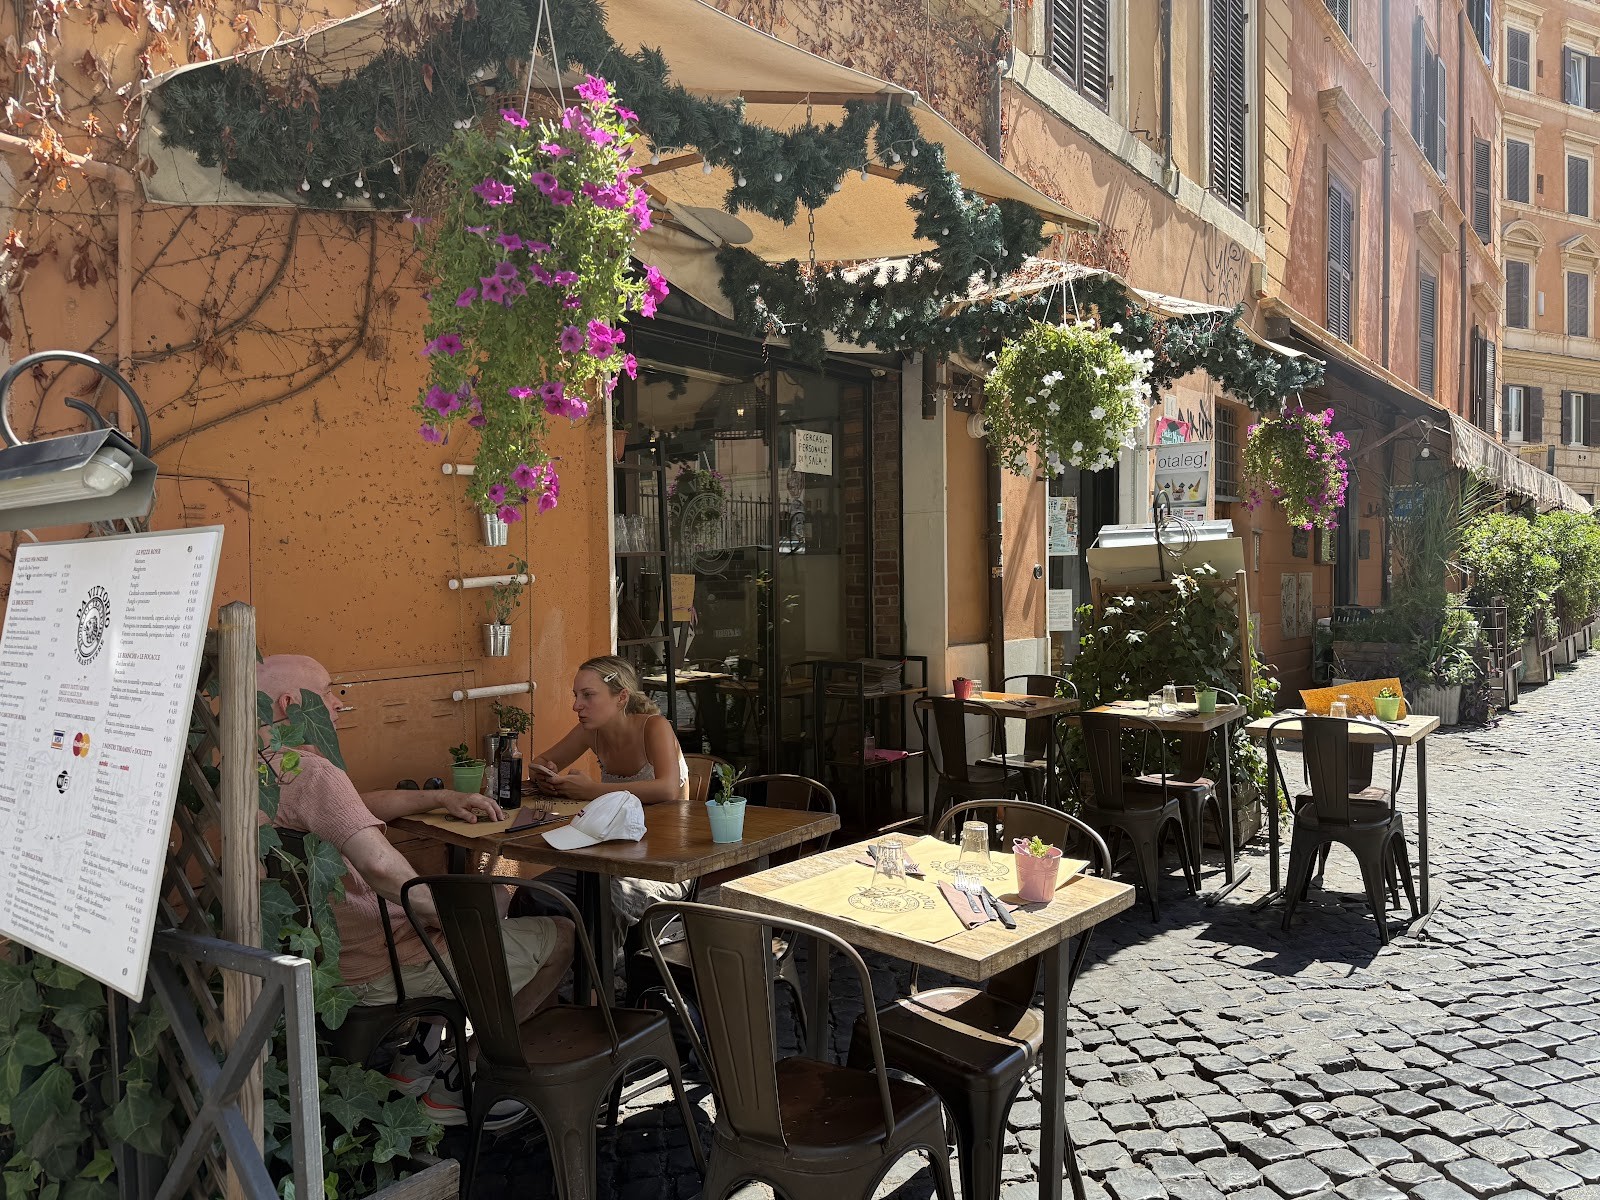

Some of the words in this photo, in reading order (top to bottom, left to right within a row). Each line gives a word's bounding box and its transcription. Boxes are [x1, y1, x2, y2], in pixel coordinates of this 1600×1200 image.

[803, 434, 825, 443] CERCASI
[798, 443, 828, 454] PERSONALE
[809, 456, 822, 465] SALA
[1158, 450, 1208, 469] otaleg!
[76, 600, 87, 618] DA
[87, 585, 111, 628] VITTORIO
